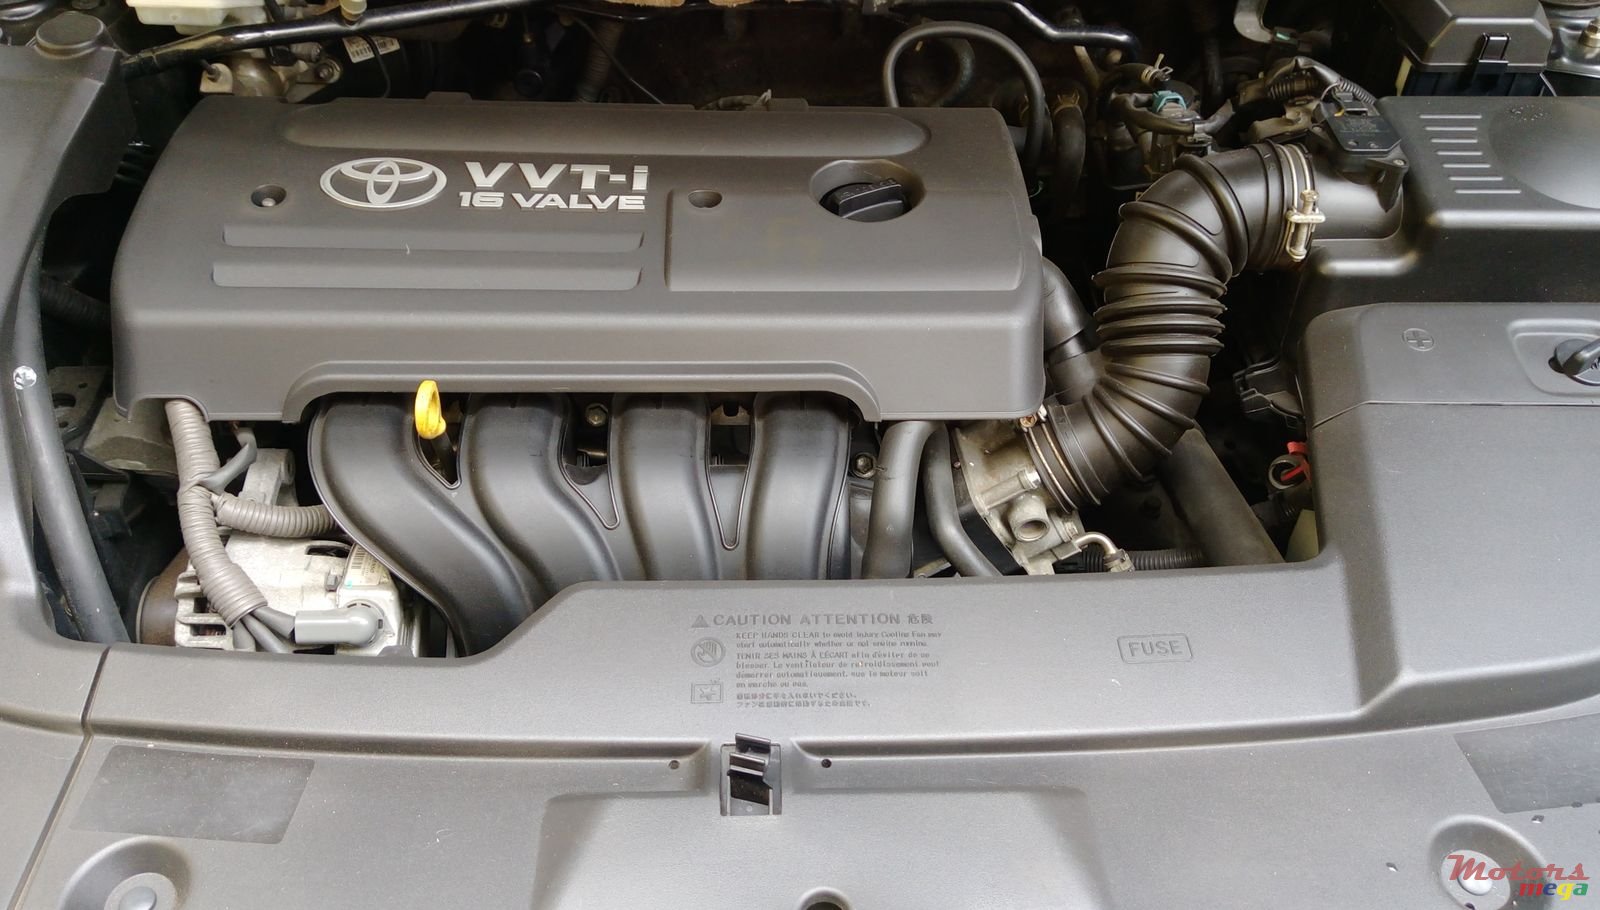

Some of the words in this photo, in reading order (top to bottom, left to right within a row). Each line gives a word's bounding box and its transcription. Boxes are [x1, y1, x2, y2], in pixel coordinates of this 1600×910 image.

[465, 161, 648, 192] VVT-i
[459, 191, 504, 209] 16
[511, 193, 646, 211] VALVE
[713, 614, 792, 626] CAUTION
[800, 613, 901, 625] ATTENTION
[1128, 640, 1182, 657] FUSE
